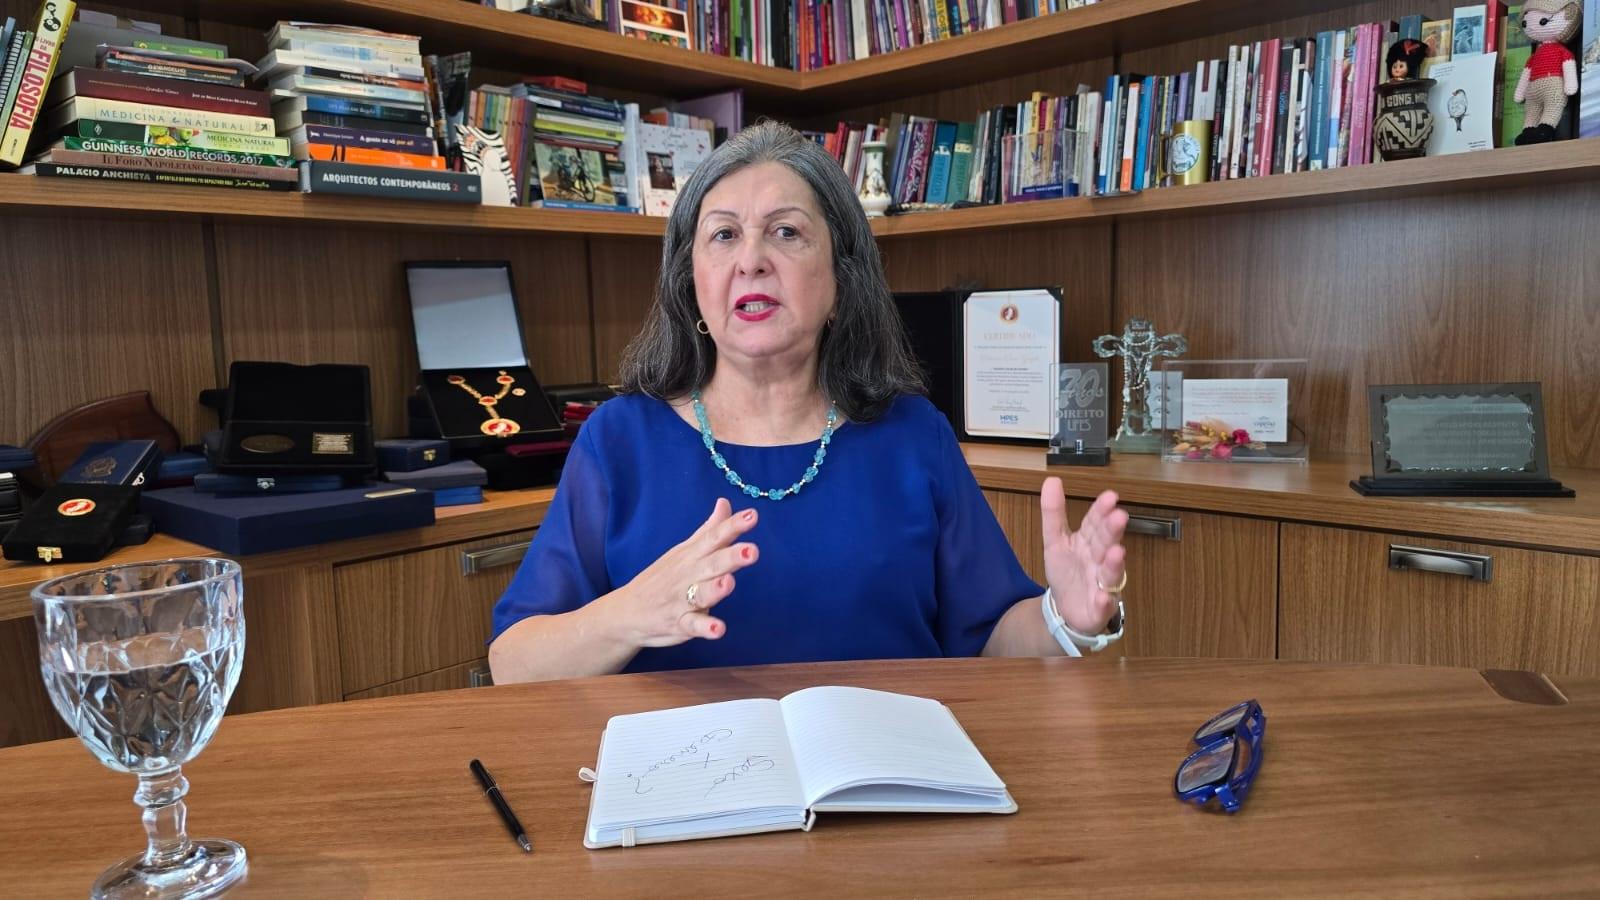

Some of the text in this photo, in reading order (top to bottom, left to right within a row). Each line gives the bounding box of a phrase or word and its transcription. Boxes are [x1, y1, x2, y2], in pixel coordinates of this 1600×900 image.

[10, 50, 52, 130] FILOSOFIA
[100, 109, 165, 121] MEDICINA
[185, 118, 246, 130] NATURAL
[206, 134, 275, 146] MEDICINA NATURAL
[82, 141, 264, 165] GUINNESS WORLD RECORDS 2017
[115, 155, 142, 166] FORO
[102, 170, 151, 180] ANCHIETA
[323, 173, 378, 185] ARQUITECTOS
[380, 179, 451, 191] CONTEMPORÂNEOS
[453, 184, 459, 192] 2
[1056, 409, 1105, 418] DIREITO
